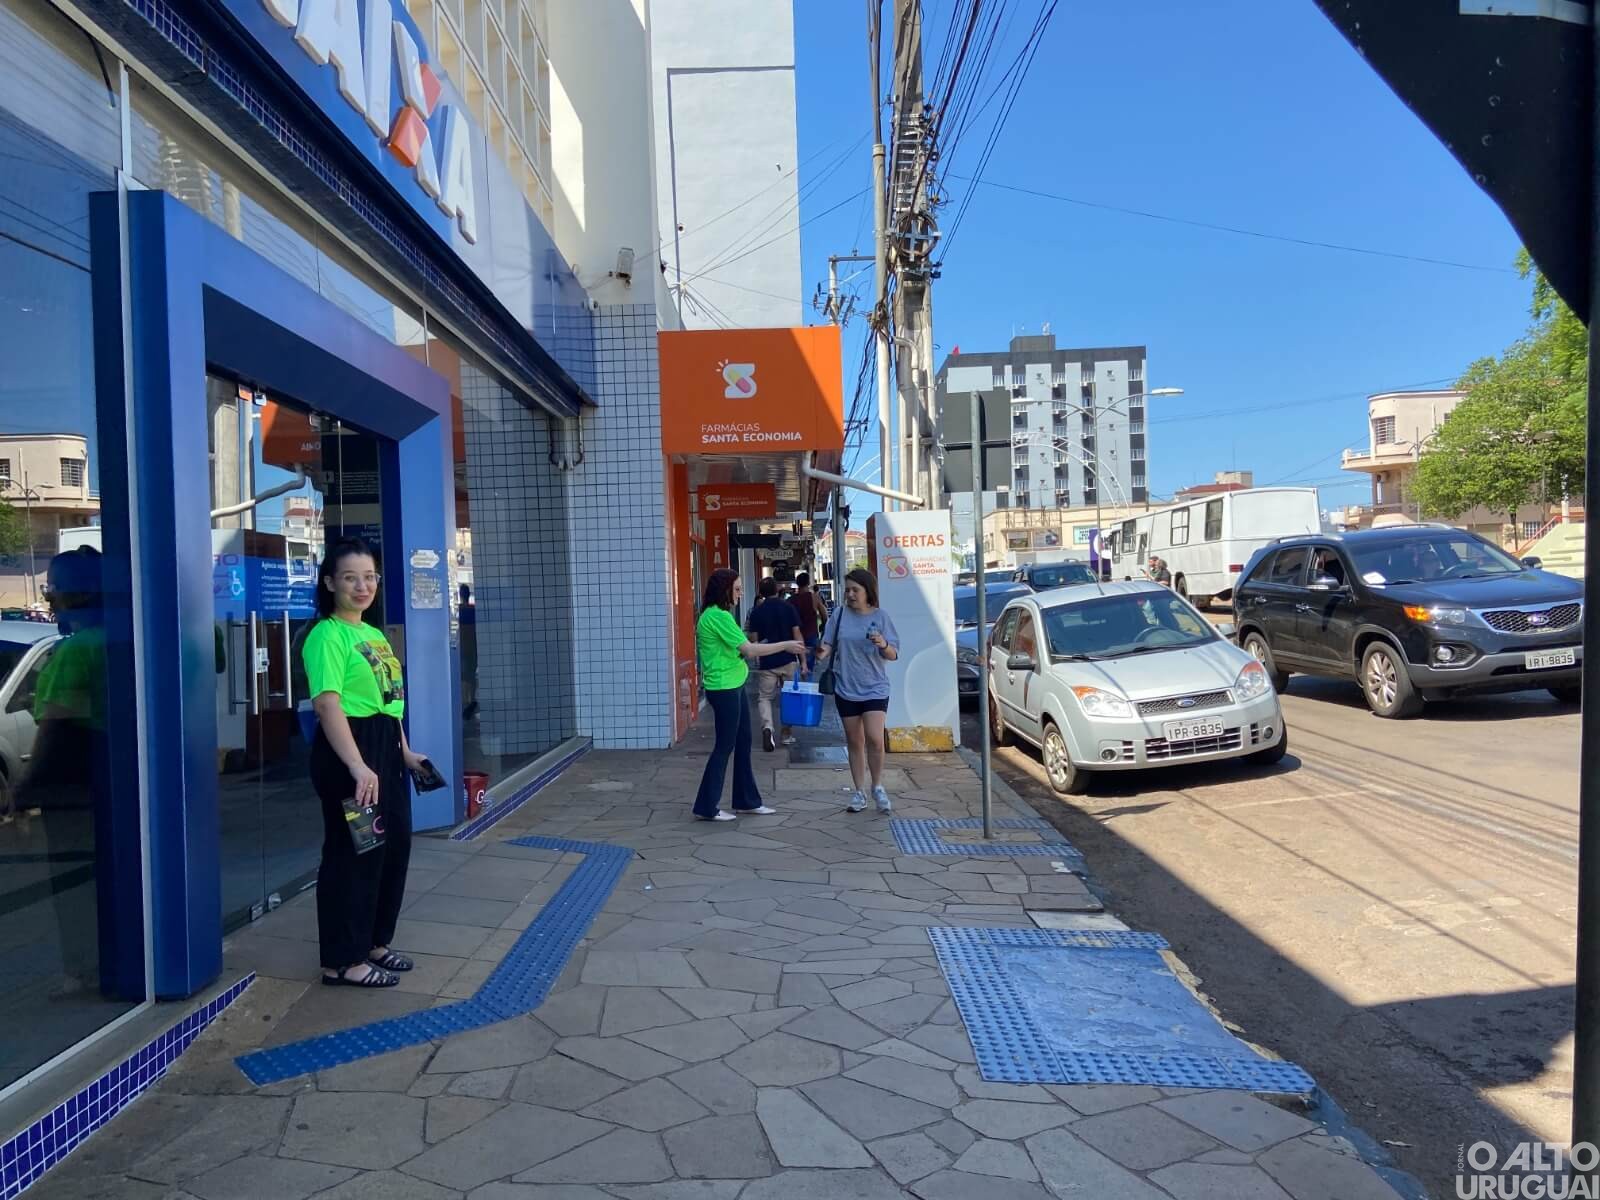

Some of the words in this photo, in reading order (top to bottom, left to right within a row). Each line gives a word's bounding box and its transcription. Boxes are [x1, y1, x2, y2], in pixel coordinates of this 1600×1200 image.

[701, 422, 761, 433] FARMÁCIAS
[702, 434, 740, 444] SANTA
[743, 432, 802, 442] ECONOMIA
[883, 534, 944, 548] OFERTAS
